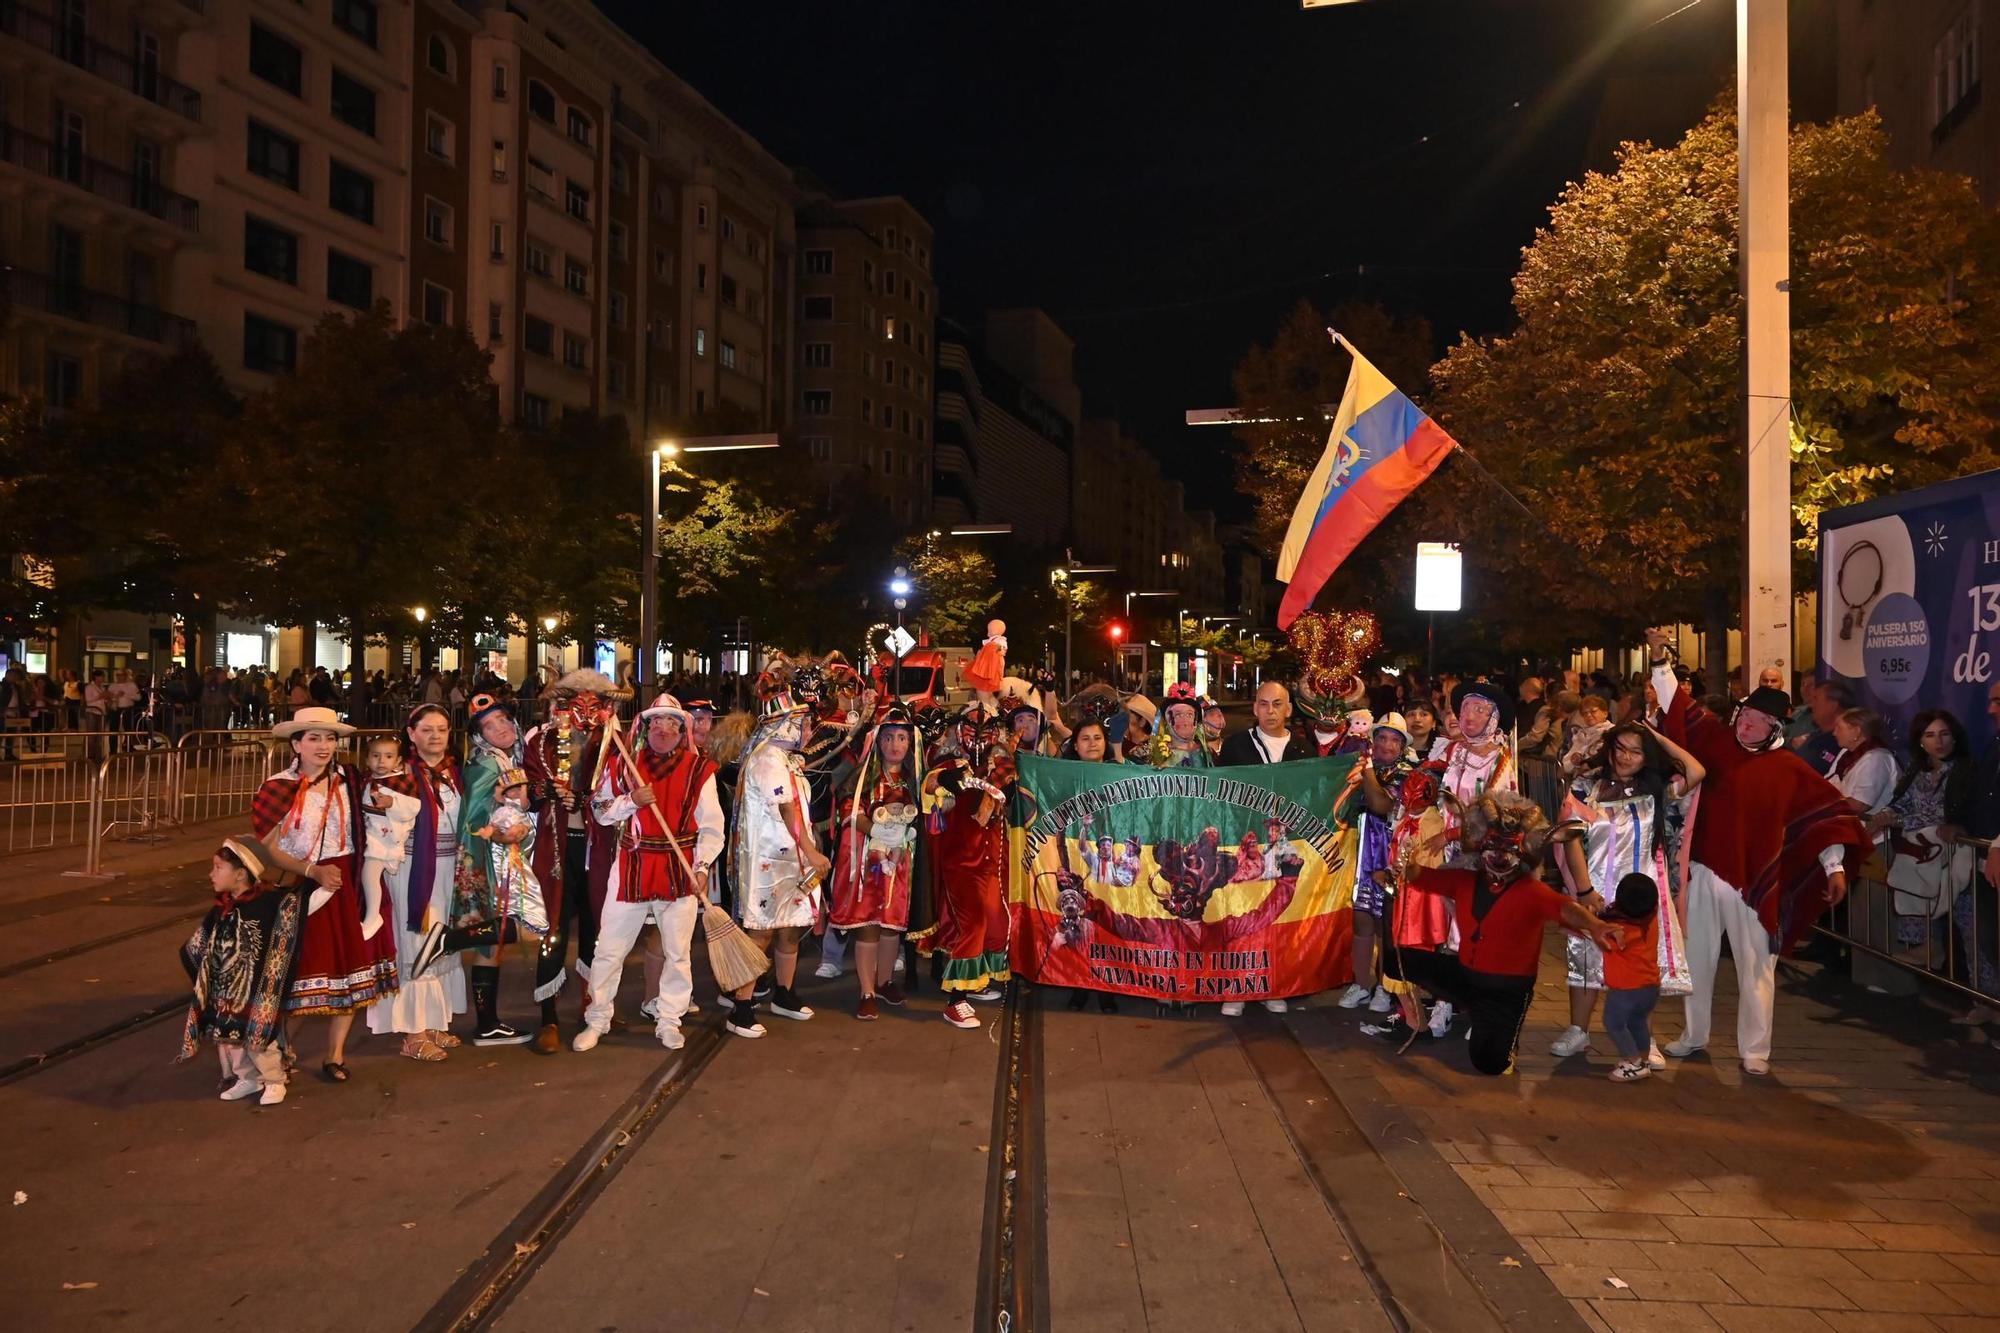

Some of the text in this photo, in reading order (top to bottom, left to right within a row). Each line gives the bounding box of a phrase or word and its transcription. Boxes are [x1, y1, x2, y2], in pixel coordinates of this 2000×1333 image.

[1968, 583, 2000, 632] 13
[1866, 633, 1928, 649] ANIVERSARIO
[1867, 619, 1926, 637] PULSERA 150
[1880, 658, 1912, 675] 6,95€
[1952, 632, 1993, 684] de
[1041, 788, 1106, 836] CULTURA
[1101, 773, 1215, 807] PATRIMONIAL,
[1215, 777, 1286, 819] DIABLOS
[1279, 801, 1308, 832] DE
[1088, 942, 1270, 971] RESIDENTES EN TUDELA
[1194, 973, 1271, 996] ESPAÑA
